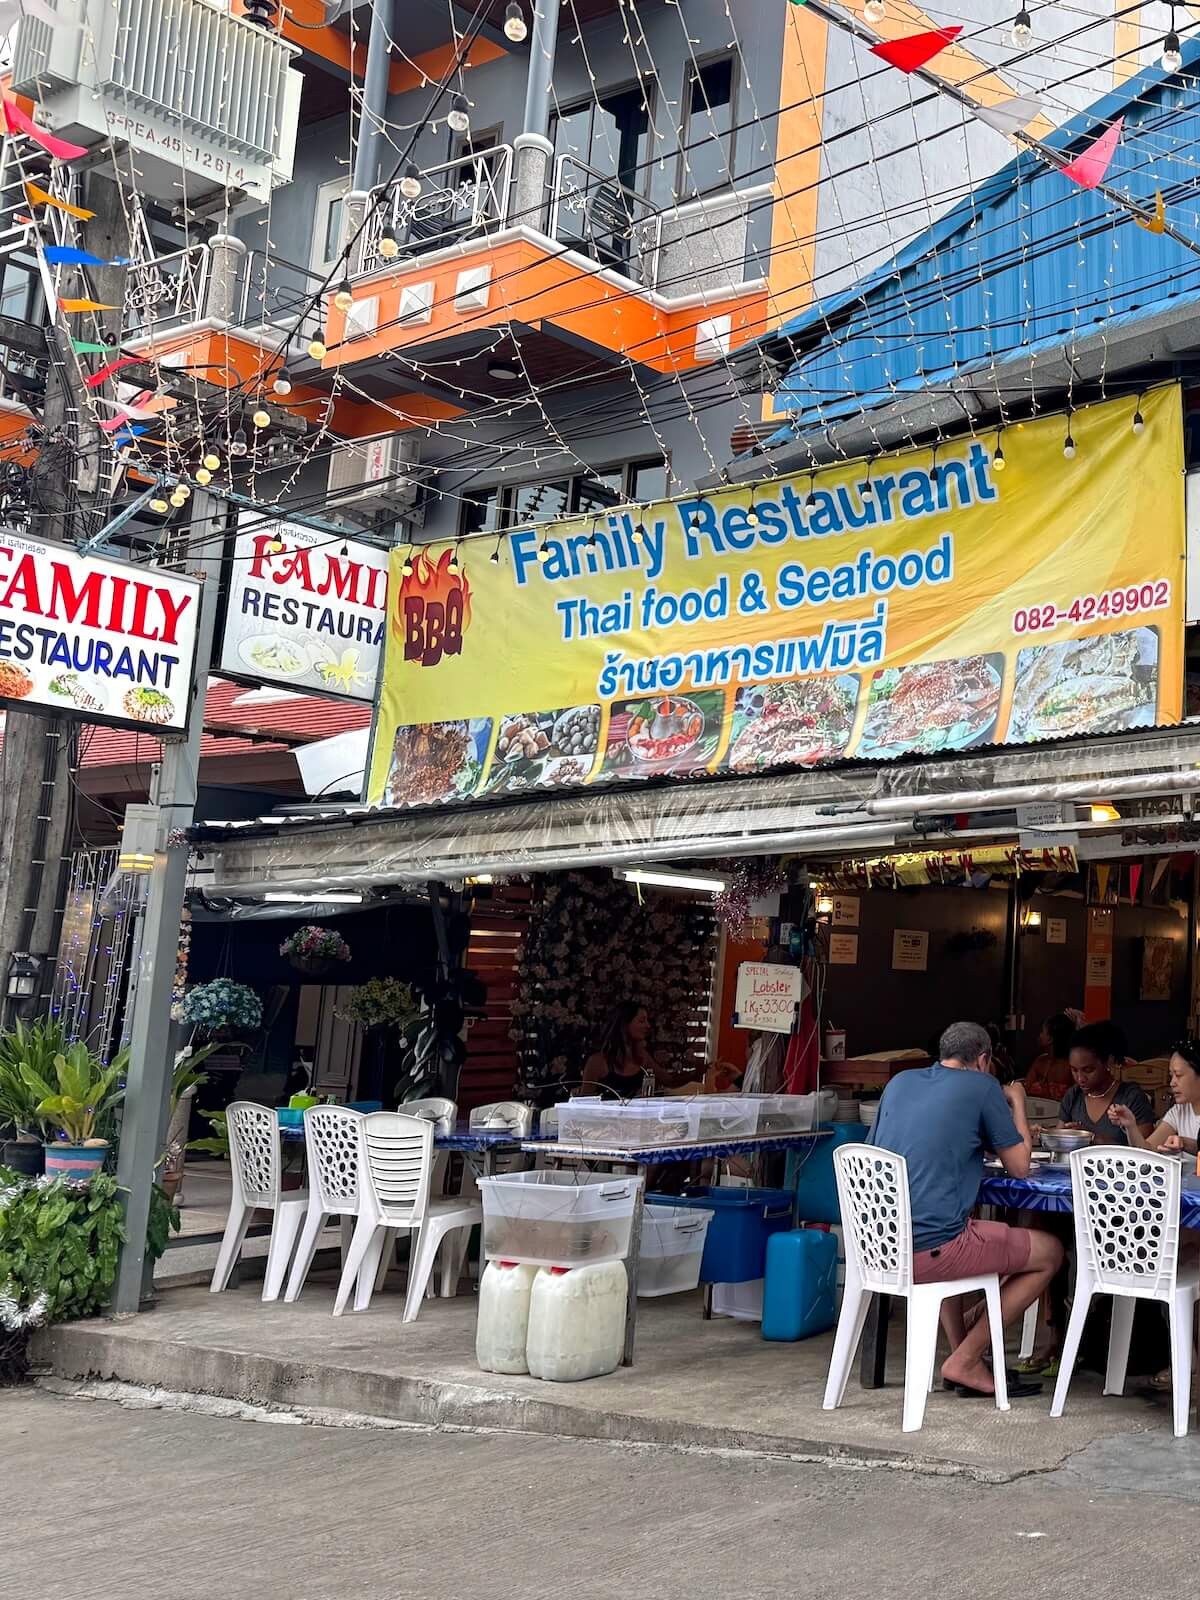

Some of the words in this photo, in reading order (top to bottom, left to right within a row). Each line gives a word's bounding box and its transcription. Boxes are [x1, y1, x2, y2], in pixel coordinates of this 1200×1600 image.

[510, 514, 666, 584] Family
[677, 444, 996, 557] Restaurant
[403, 587, 464, 666] BBQ
[557, 593, 632, 638] Thai
[642, 577, 728, 627] food
[739, 573, 767, 613] &
[778, 536, 951, 607] Seafood
[1013, 582, 1169, 632] 082-4249902
[599, 603, 886, 696] ร้านอาหารแฟมิลี่
[745, 966, 769, 977] SPECIAL
[752, 979, 792, 994] Lobster
